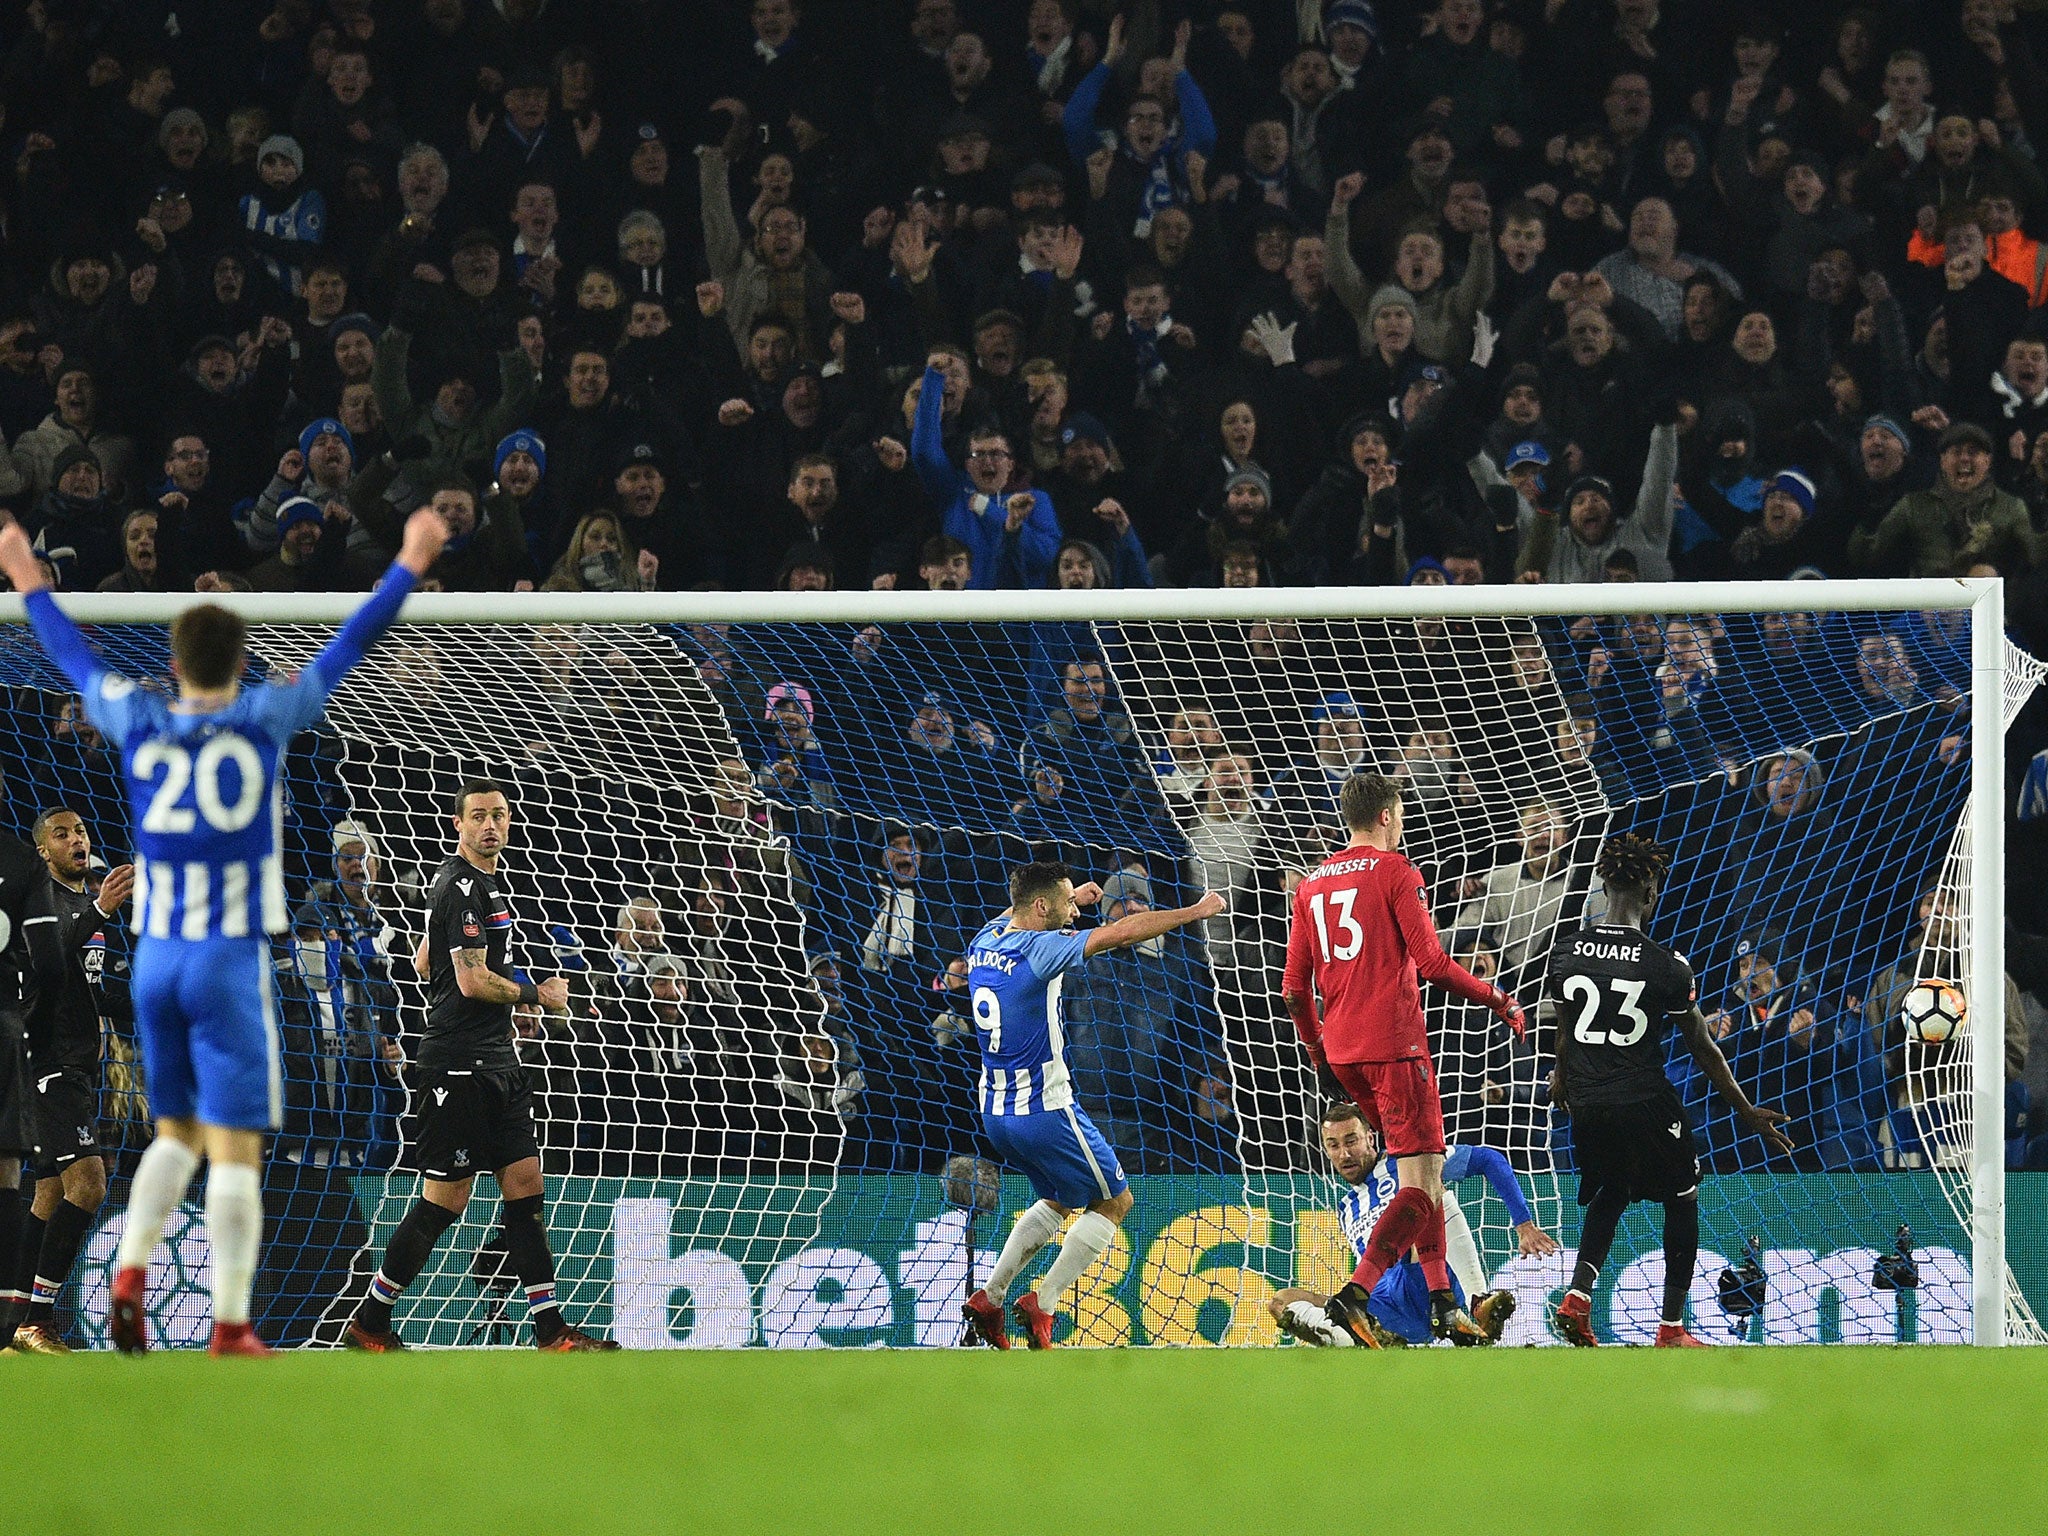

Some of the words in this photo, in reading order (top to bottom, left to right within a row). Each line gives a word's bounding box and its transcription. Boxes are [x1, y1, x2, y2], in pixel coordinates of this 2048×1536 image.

[131, 731, 266, 833] 20
[1309, 887, 1364, 962] 13
[1572, 940, 1643, 963] SOUARÉ
[972, 986, 1001, 1053] 9
[1562, 974, 1649, 1047] 23
